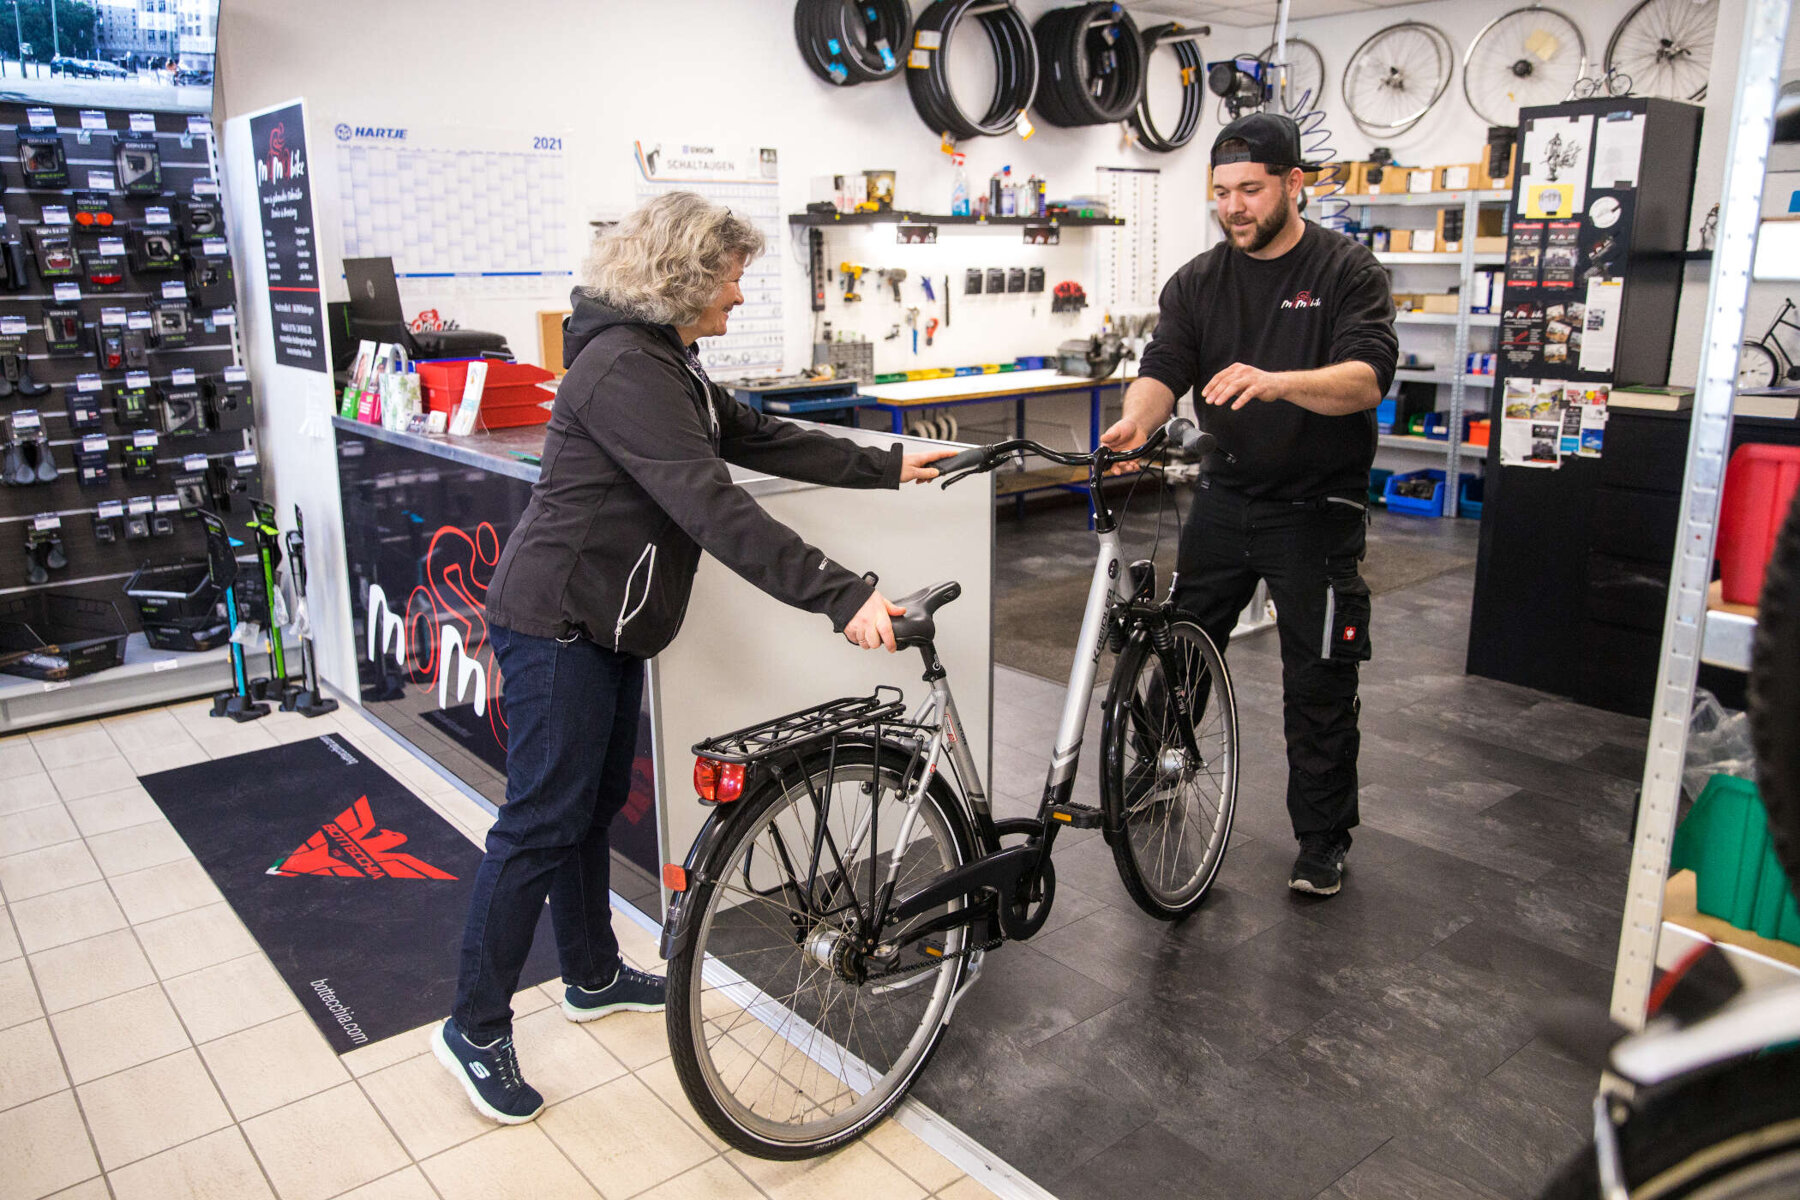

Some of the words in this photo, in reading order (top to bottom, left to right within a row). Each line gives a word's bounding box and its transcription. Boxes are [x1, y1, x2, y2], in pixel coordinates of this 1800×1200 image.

[354, 127, 408, 140] HARTJE
[533, 136, 564, 150] 2021
[667, 159, 735, 172] SCHALTAUGEN
[322, 823, 386, 880] BOTTECCHIA
[310, 978, 369, 1045] bottecchia.com
